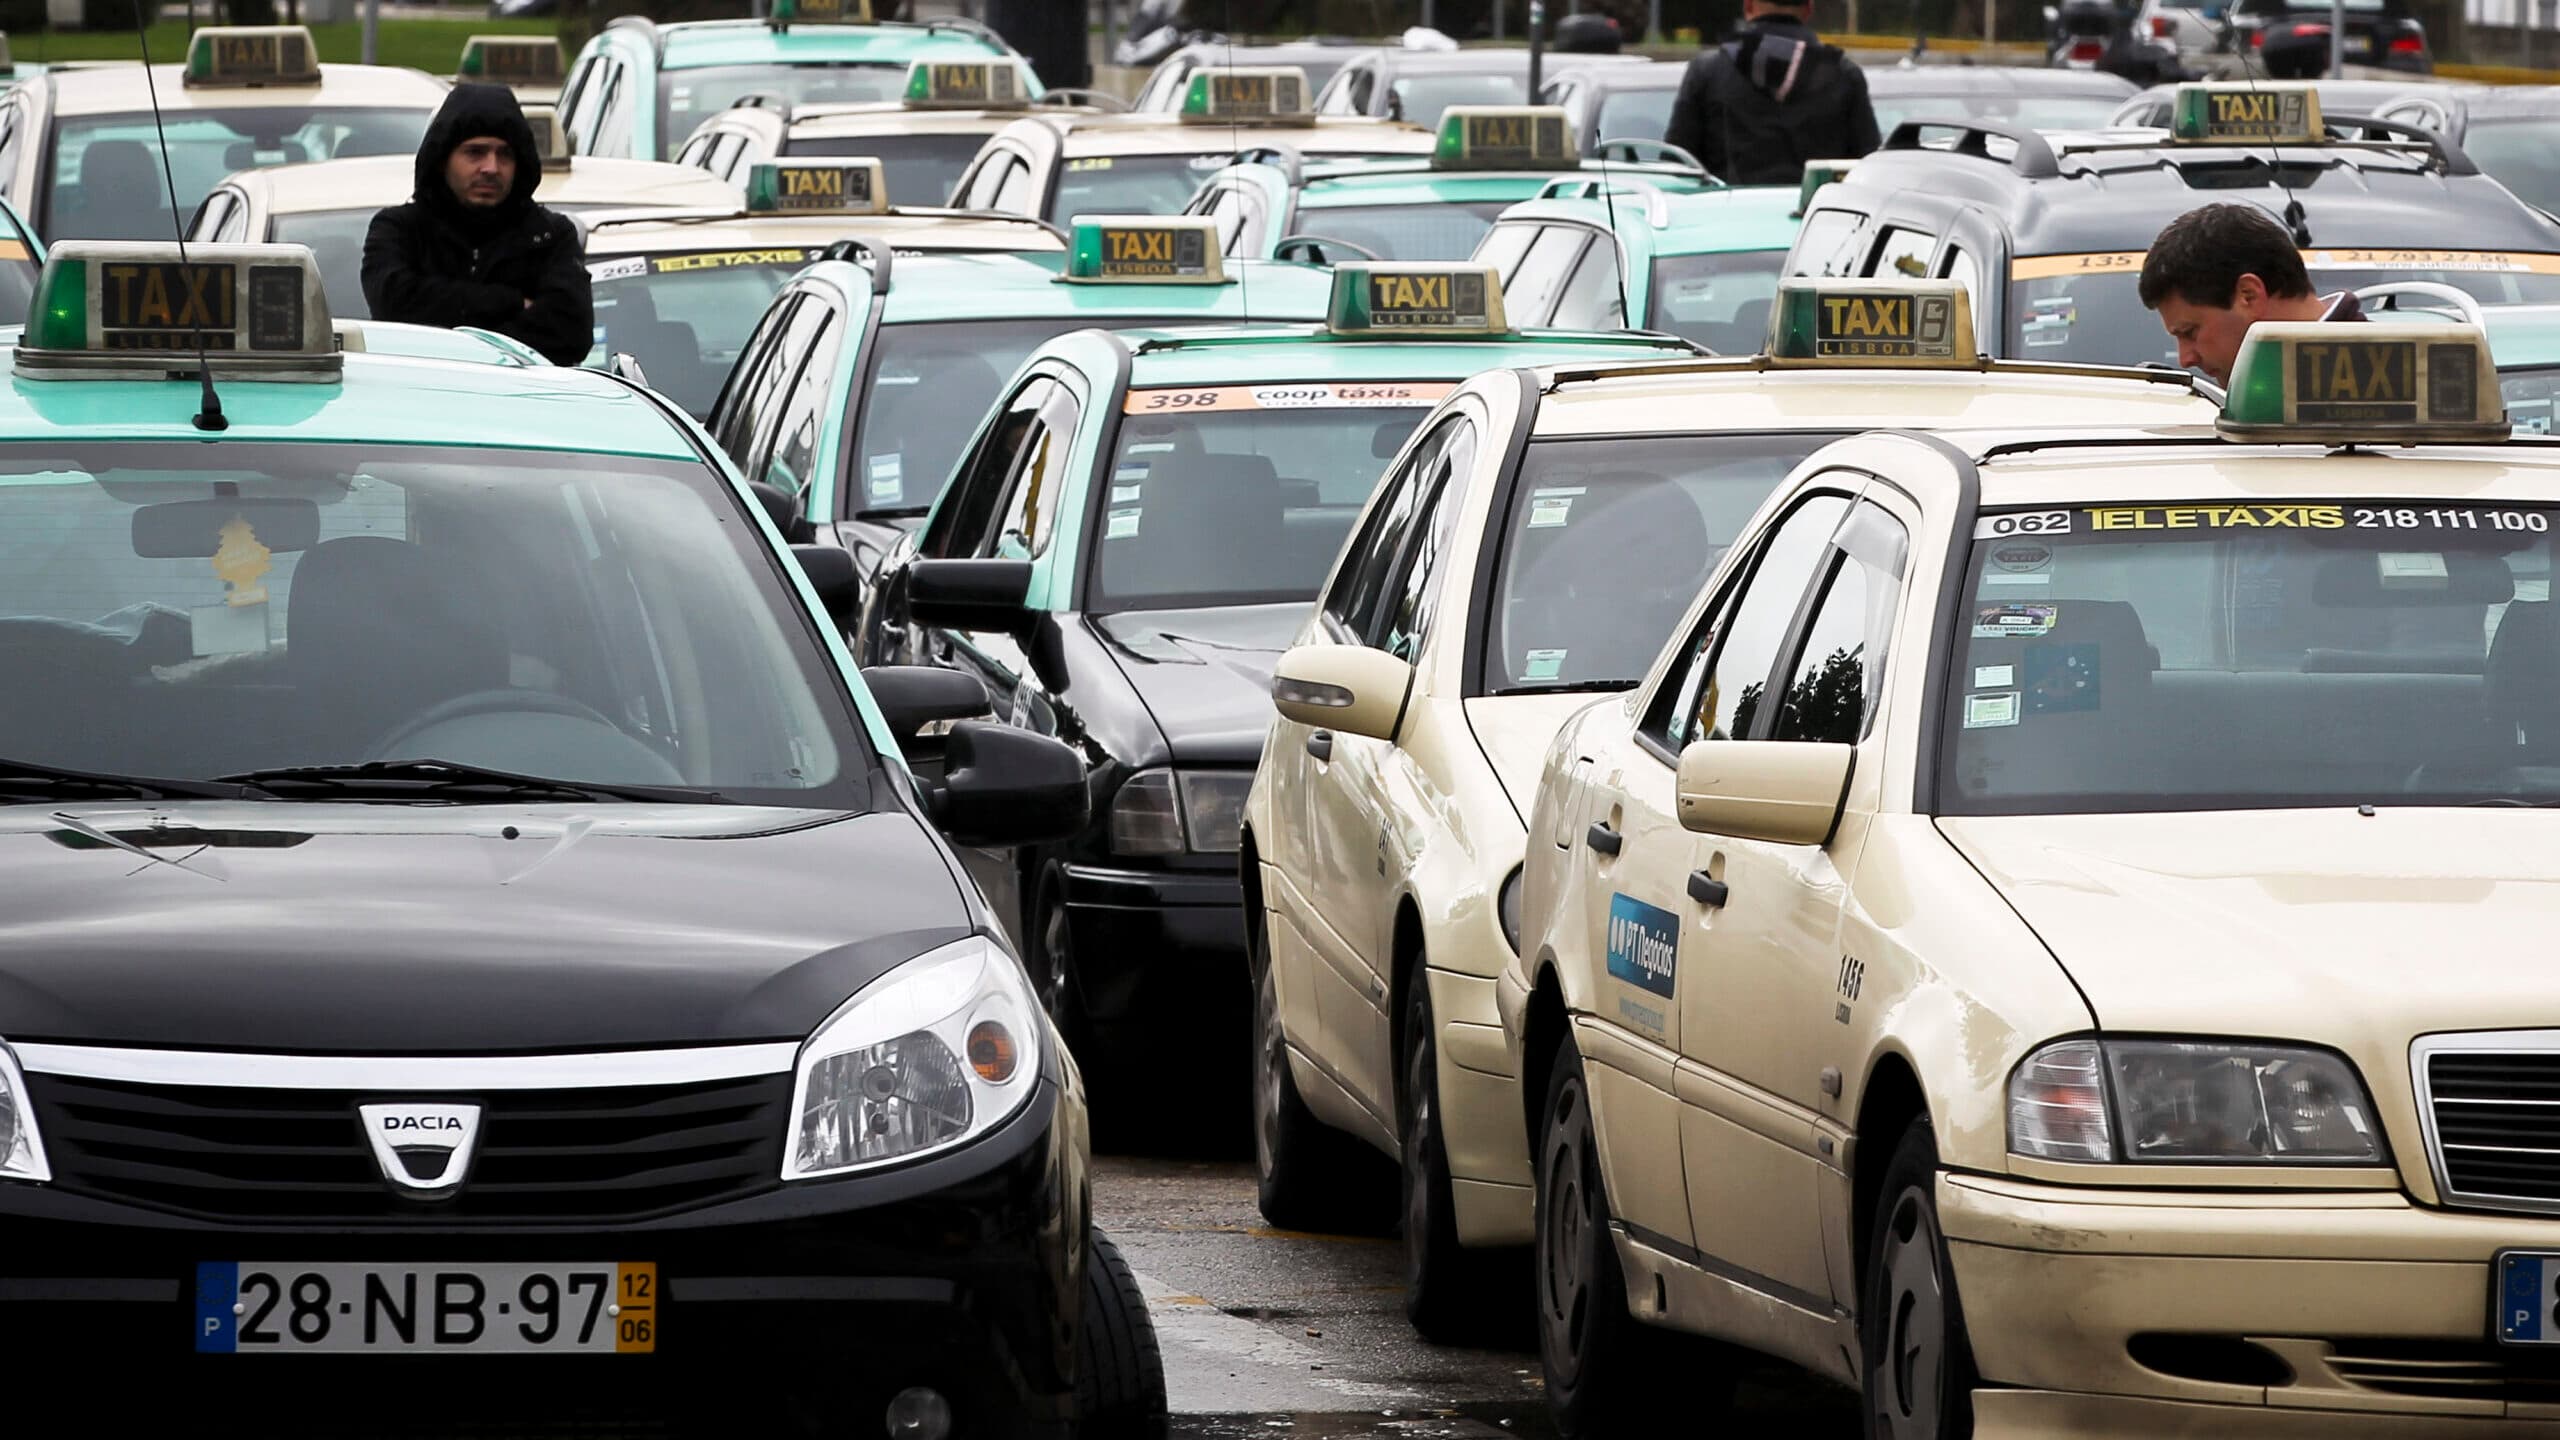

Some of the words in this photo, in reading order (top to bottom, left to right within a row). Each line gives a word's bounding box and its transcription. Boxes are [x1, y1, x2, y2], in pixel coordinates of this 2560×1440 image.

[220, 38, 276, 64] TAXI
[936, 64, 986, 88] TAXI
[1216, 76, 1270, 102] TAXI
[2212, 94, 2275, 121] TAXI
[1472, 119, 1532, 147] TAXI
[782, 170, 841, 195] TAXI
[1106, 232, 1173, 260] TAXI
[1105, 264, 1173, 274] LISBOA
[2079, 256, 2132, 267] 135
[109, 267, 232, 325] TAXI
[1375, 277, 1449, 308] TAXI
[1377, 315, 1449, 324] LISBOA
[1824, 299, 1909, 336] TAXI
[1824, 343, 1910, 354] LISBOA
[2303, 346, 2414, 399] TAXI
[1145, 392, 1219, 409] 398
[1256, 388, 1328, 401] coop
[1338, 386, 1412, 399] táxis
[1993, 514, 2070, 534] 062
[2353, 509, 2420, 528] 218
[2424, 509, 2478, 529] 111
[2485, 511, 2549, 532] 100
[1625, 919, 1639, 963] PT
[1637, 925, 1674, 981] Negócios
[1837, 953, 1865, 1001] 1456
[384, 1116, 463, 1130] DACIA
[624, 1274, 650, 1297] 12
[204, 1317, 221, 1337] P
[2516, 1309, 2530, 1328] P
[620, 1319, 651, 1344] 06
